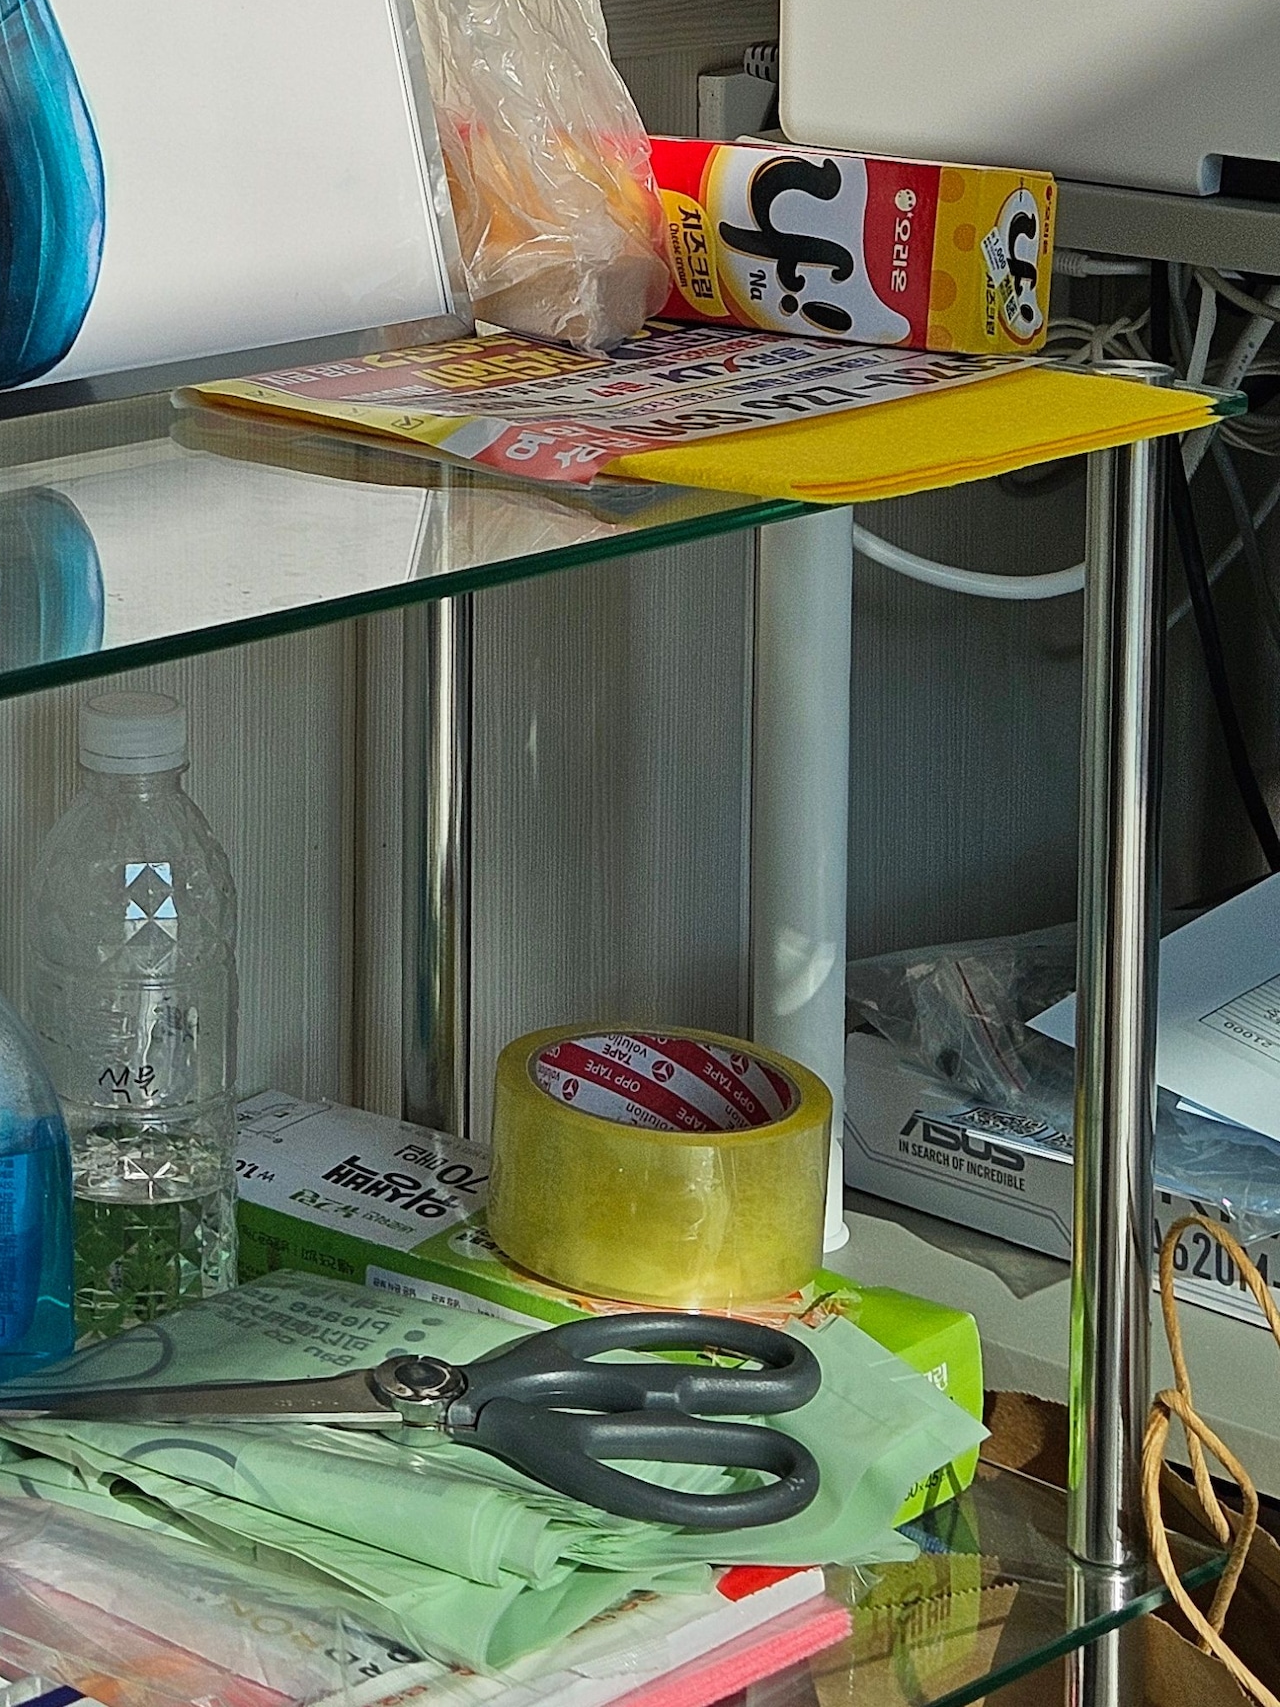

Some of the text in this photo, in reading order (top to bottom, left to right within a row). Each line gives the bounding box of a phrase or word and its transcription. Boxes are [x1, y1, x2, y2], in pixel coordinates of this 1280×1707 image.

[669, 223, 689, 288] Cheese cream
[678, 204, 715, 300] 치즈크림
[891, 218, 912, 293] 오리온
[749, 269, 768, 301] Na
[411, 347, 609, 389] 4억5천
[610, 408, 776, 438] 063)
[602, 1044, 633, 1066] TAPE
[1223, 1020, 1273, 1049] 21000
[584, 1057, 641, 1093] OPP TAPE
[703, 1061, 756, 1114] OPP TAPE
[675, 1106, 708, 1132] TAPE
[899, 1139, 1026, 1192] IN SEARCH OF INCREDIBLE
[321, 1155, 458, 1219] 위생백
